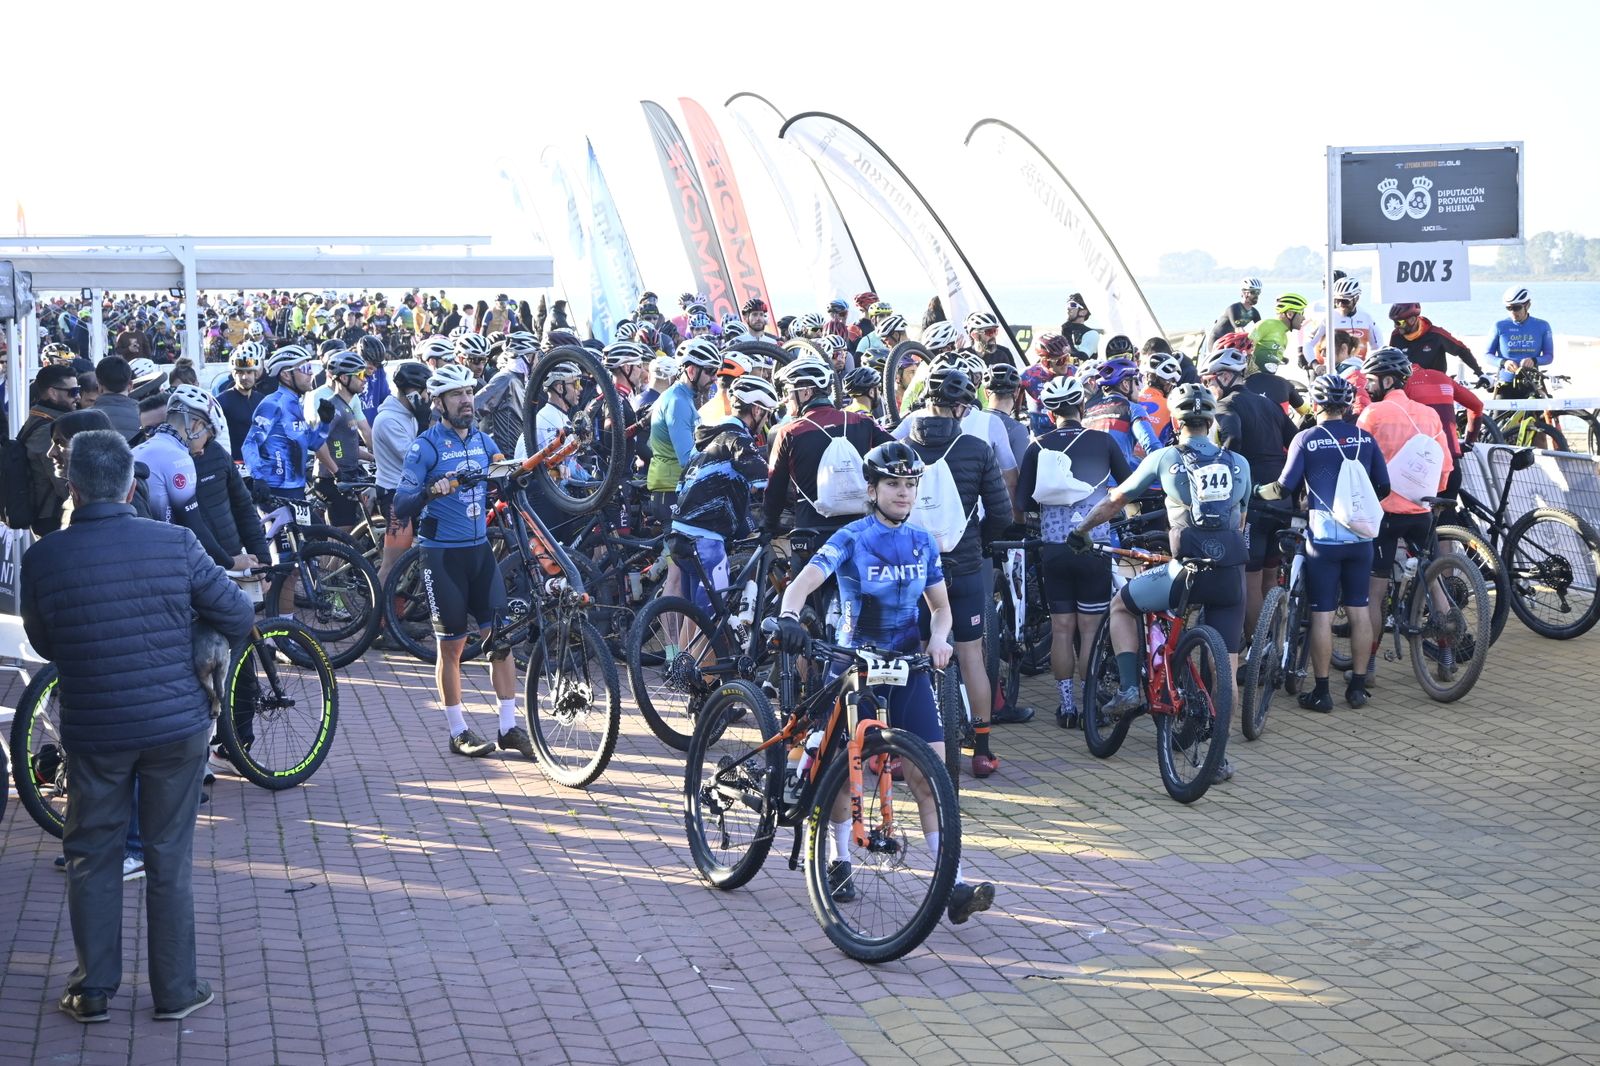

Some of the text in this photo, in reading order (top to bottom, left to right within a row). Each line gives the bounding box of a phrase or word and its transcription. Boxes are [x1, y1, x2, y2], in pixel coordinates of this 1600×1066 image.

[1437, 186, 1485, 198] DIPUTACIÓN
[1437, 195, 1485, 206] PROVINCIAL
[1445, 204, 1476, 213] HUELVA
[1396, 259, 1453, 283] BOX 3
[1200, 473, 1228, 490] 344
[866, 559, 927, 581] FANTÉ
